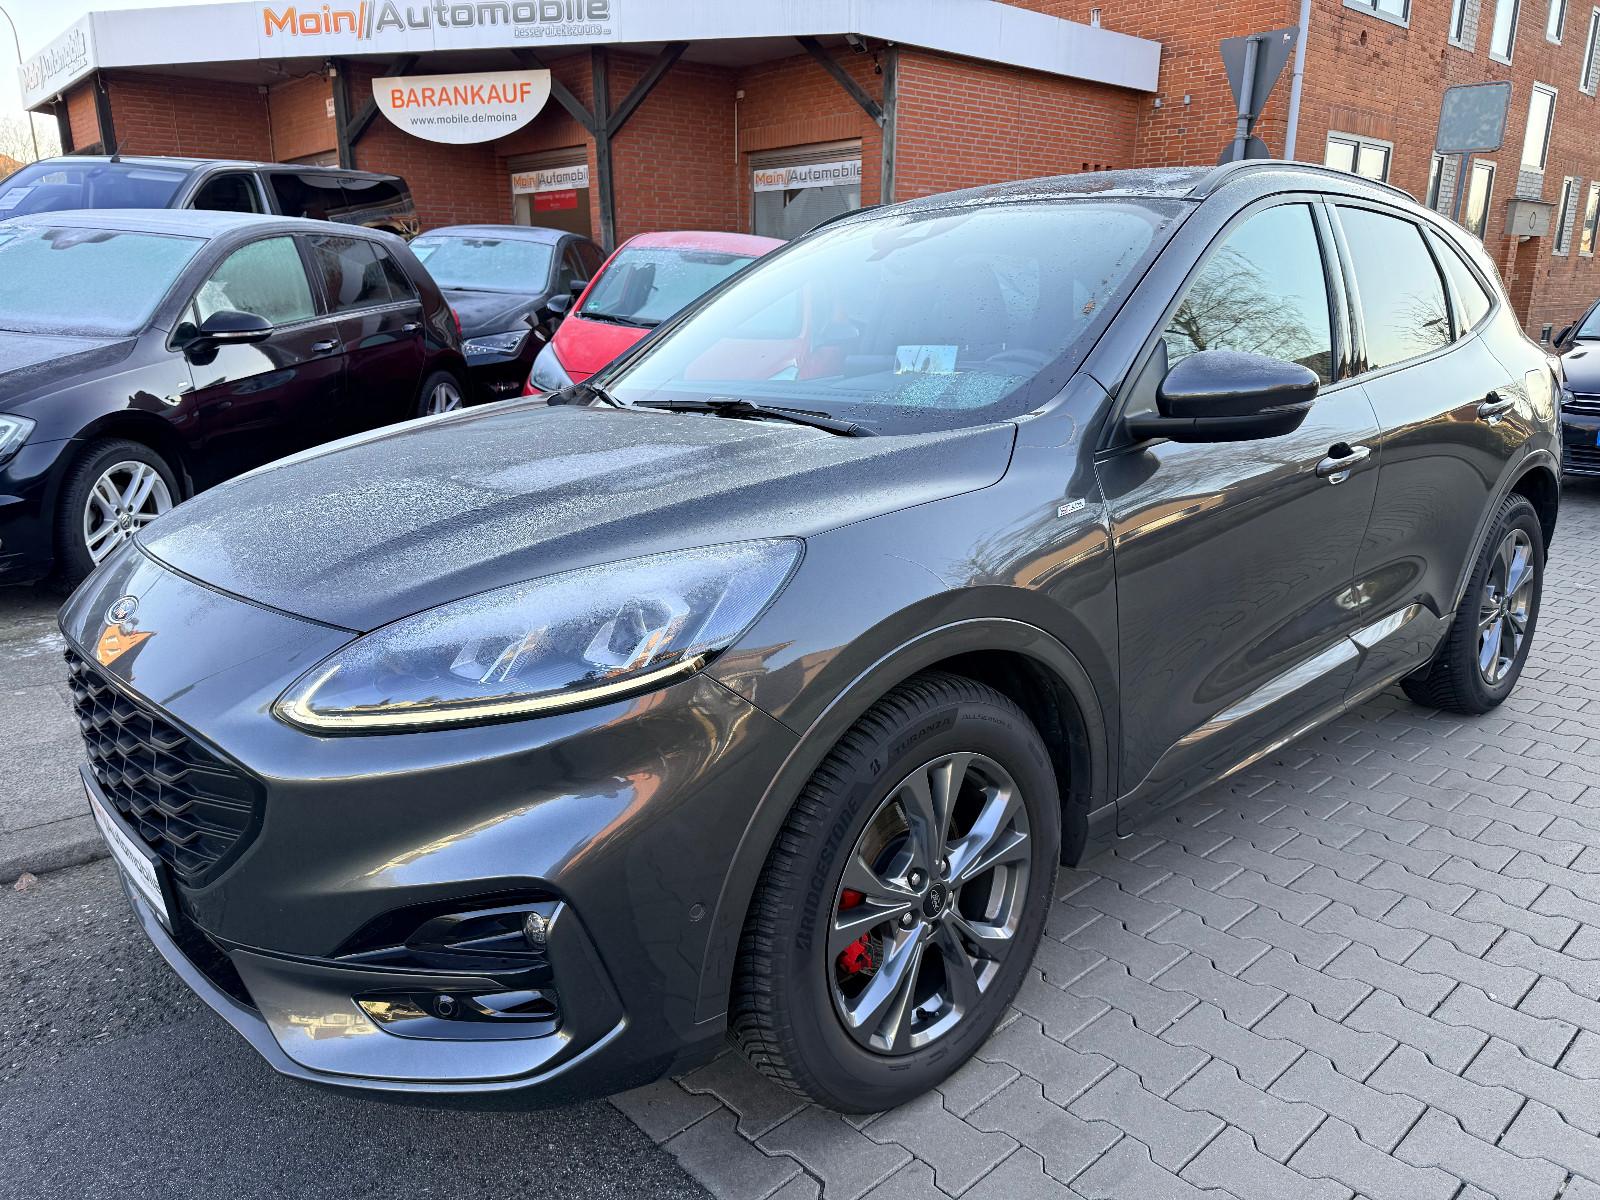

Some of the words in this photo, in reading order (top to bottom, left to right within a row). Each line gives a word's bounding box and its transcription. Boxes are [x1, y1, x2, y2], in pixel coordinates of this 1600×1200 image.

[391, 82, 532, 108] BARANKAUF
[410, 112, 517, 125] www.mobile.de/moina
[796, 798, 858, 950] BRIDGESTONE
